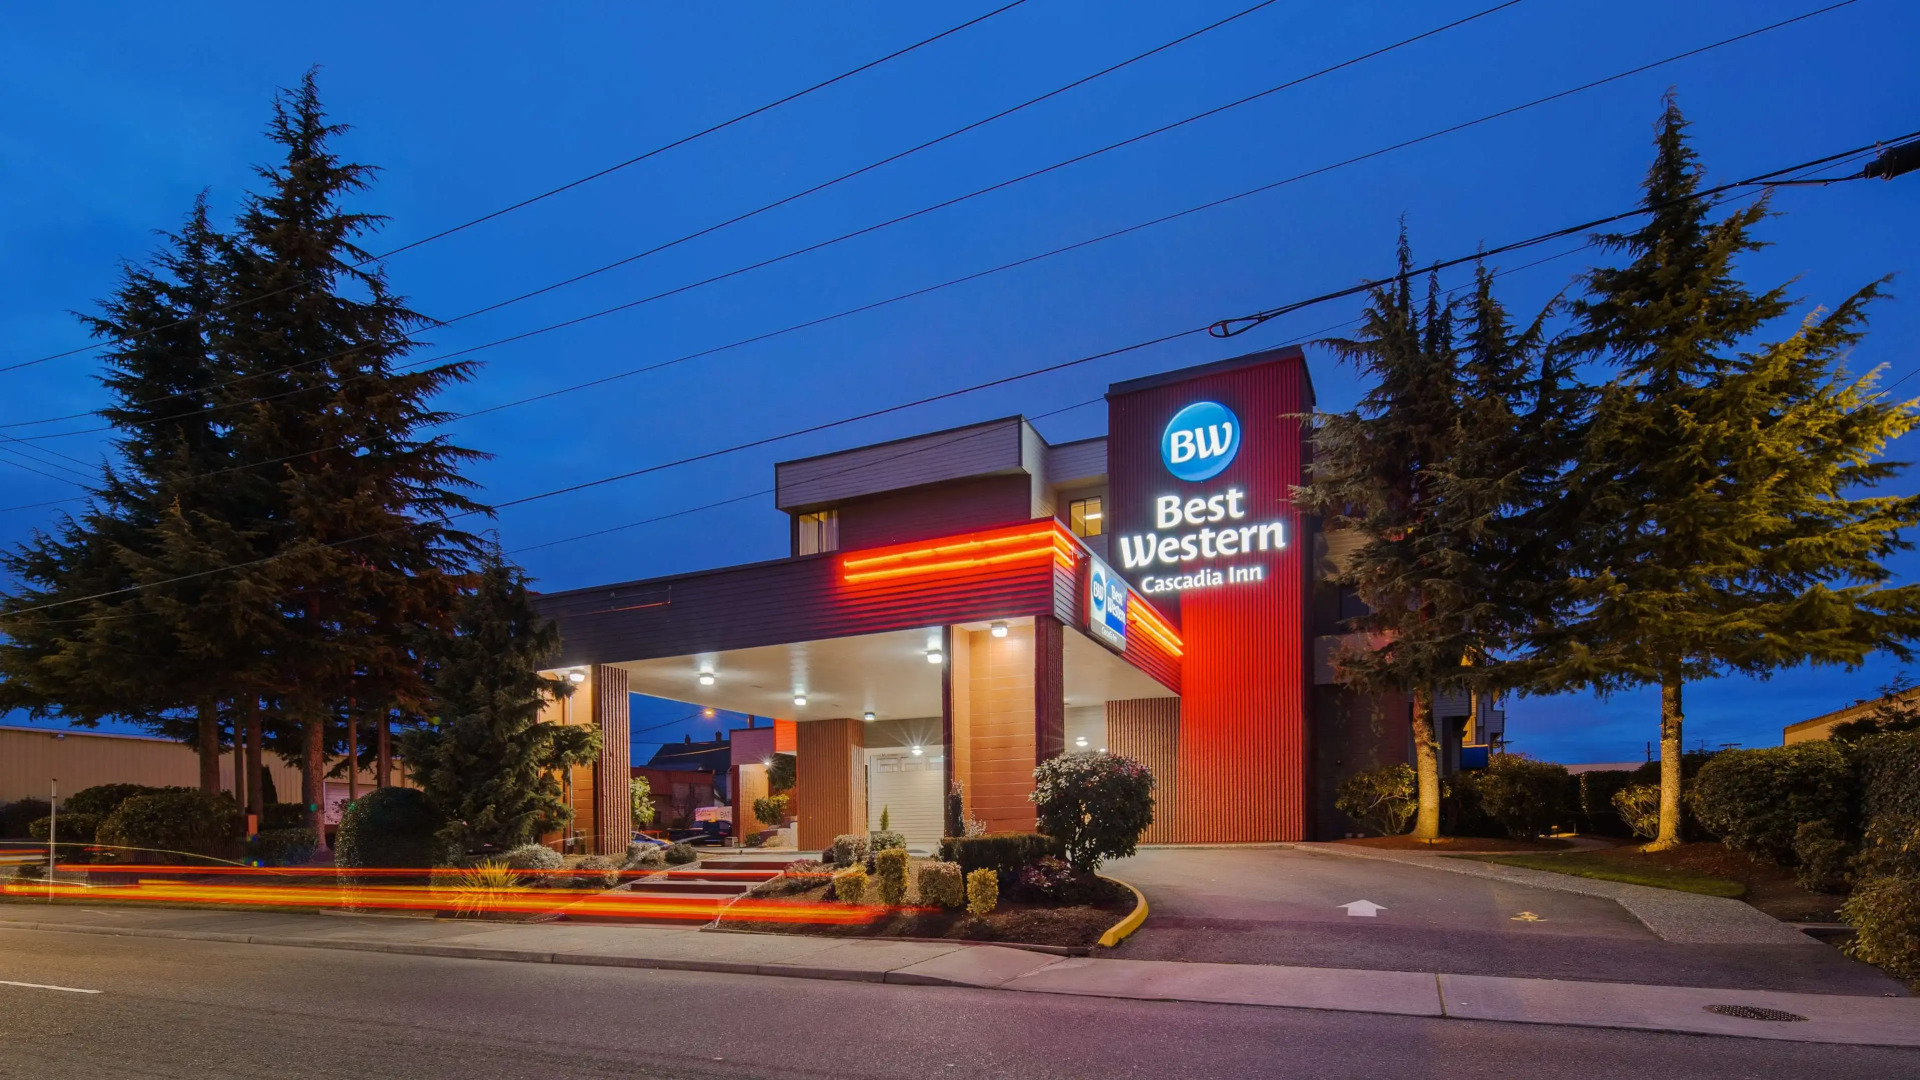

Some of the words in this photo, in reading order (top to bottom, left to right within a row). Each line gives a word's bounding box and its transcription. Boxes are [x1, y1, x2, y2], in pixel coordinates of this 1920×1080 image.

[1171, 422, 1233, 464] BW
[1157, 488, 1245, 529] Best
[1120, 521, 1286, 569] Western
[1093, 581, 1104, 601] BW
[1141, 568, 1223, 593] Cascadia
[1229, 566, 1263, 583] Inn
[1111, 585, 1123, 606] Best
[1107, 596, 1126, 625] Western
